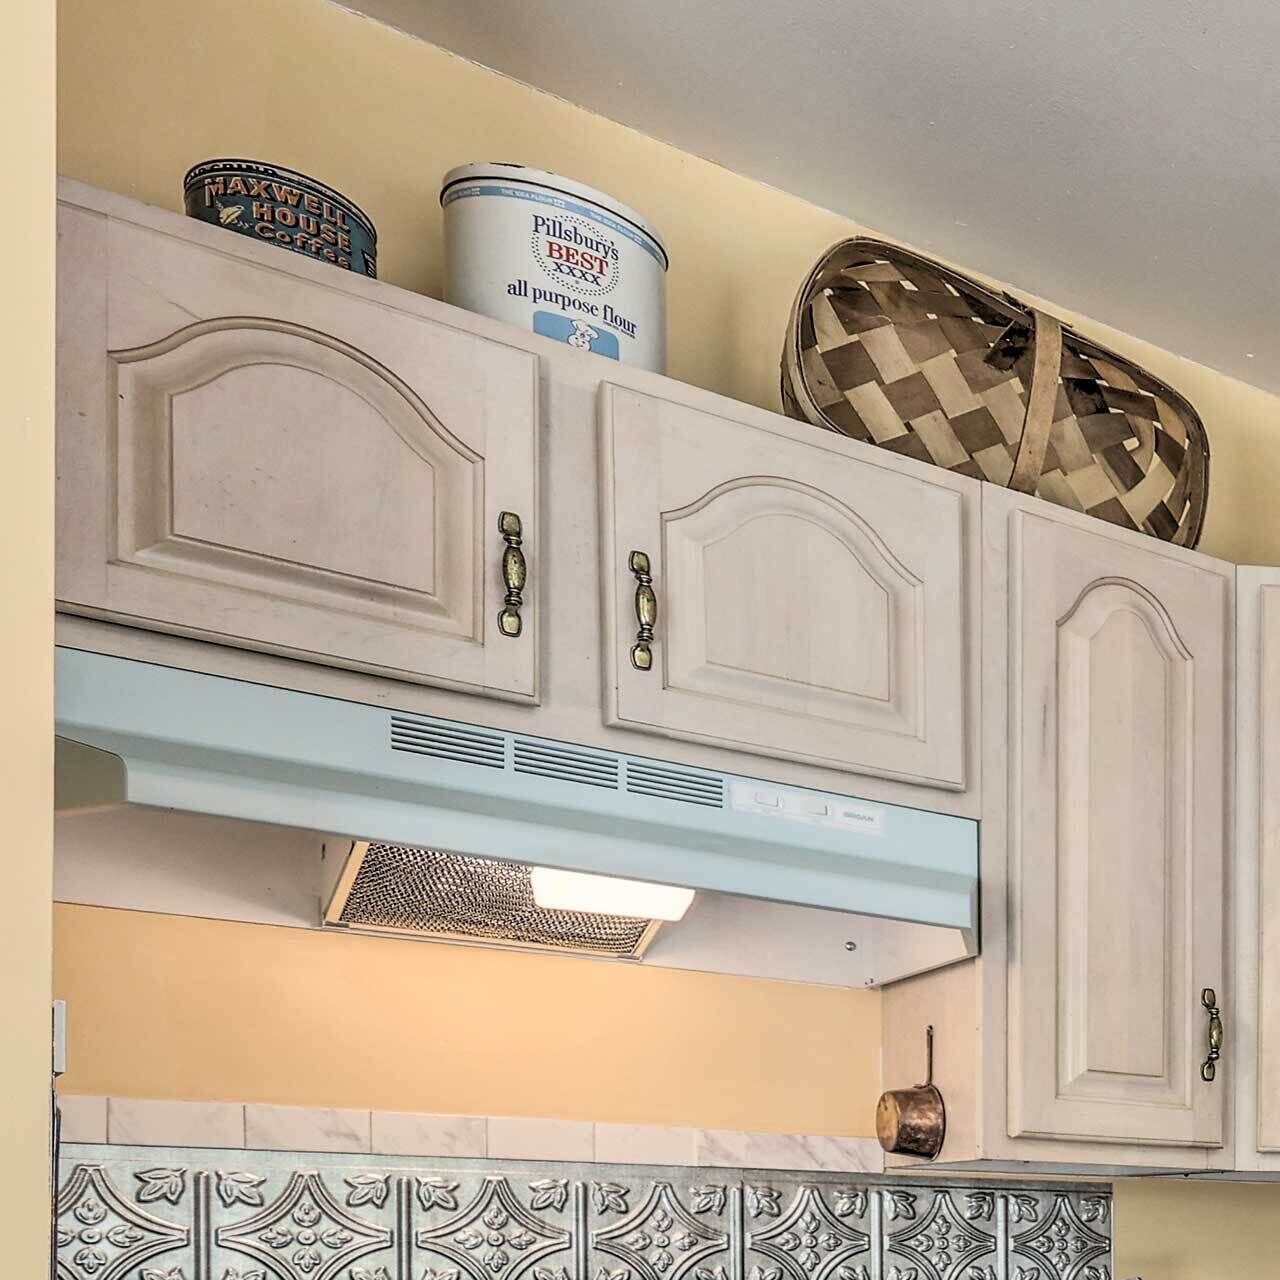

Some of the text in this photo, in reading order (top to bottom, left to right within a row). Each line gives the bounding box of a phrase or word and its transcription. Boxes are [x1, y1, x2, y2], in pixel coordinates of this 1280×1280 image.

[204, 176, 351, 231] MAXWELL
[252, 201, 352, 252] HOUSE
[254, 223, 351, 269] Coffee
[532, 214, 620, 262] Pillsbury's
[546, 240, 609, 276] BEST
[507, 279, 528, 298] all
[532, 286, 598, 318] purpose
[602, 304, 638, 335] flour
